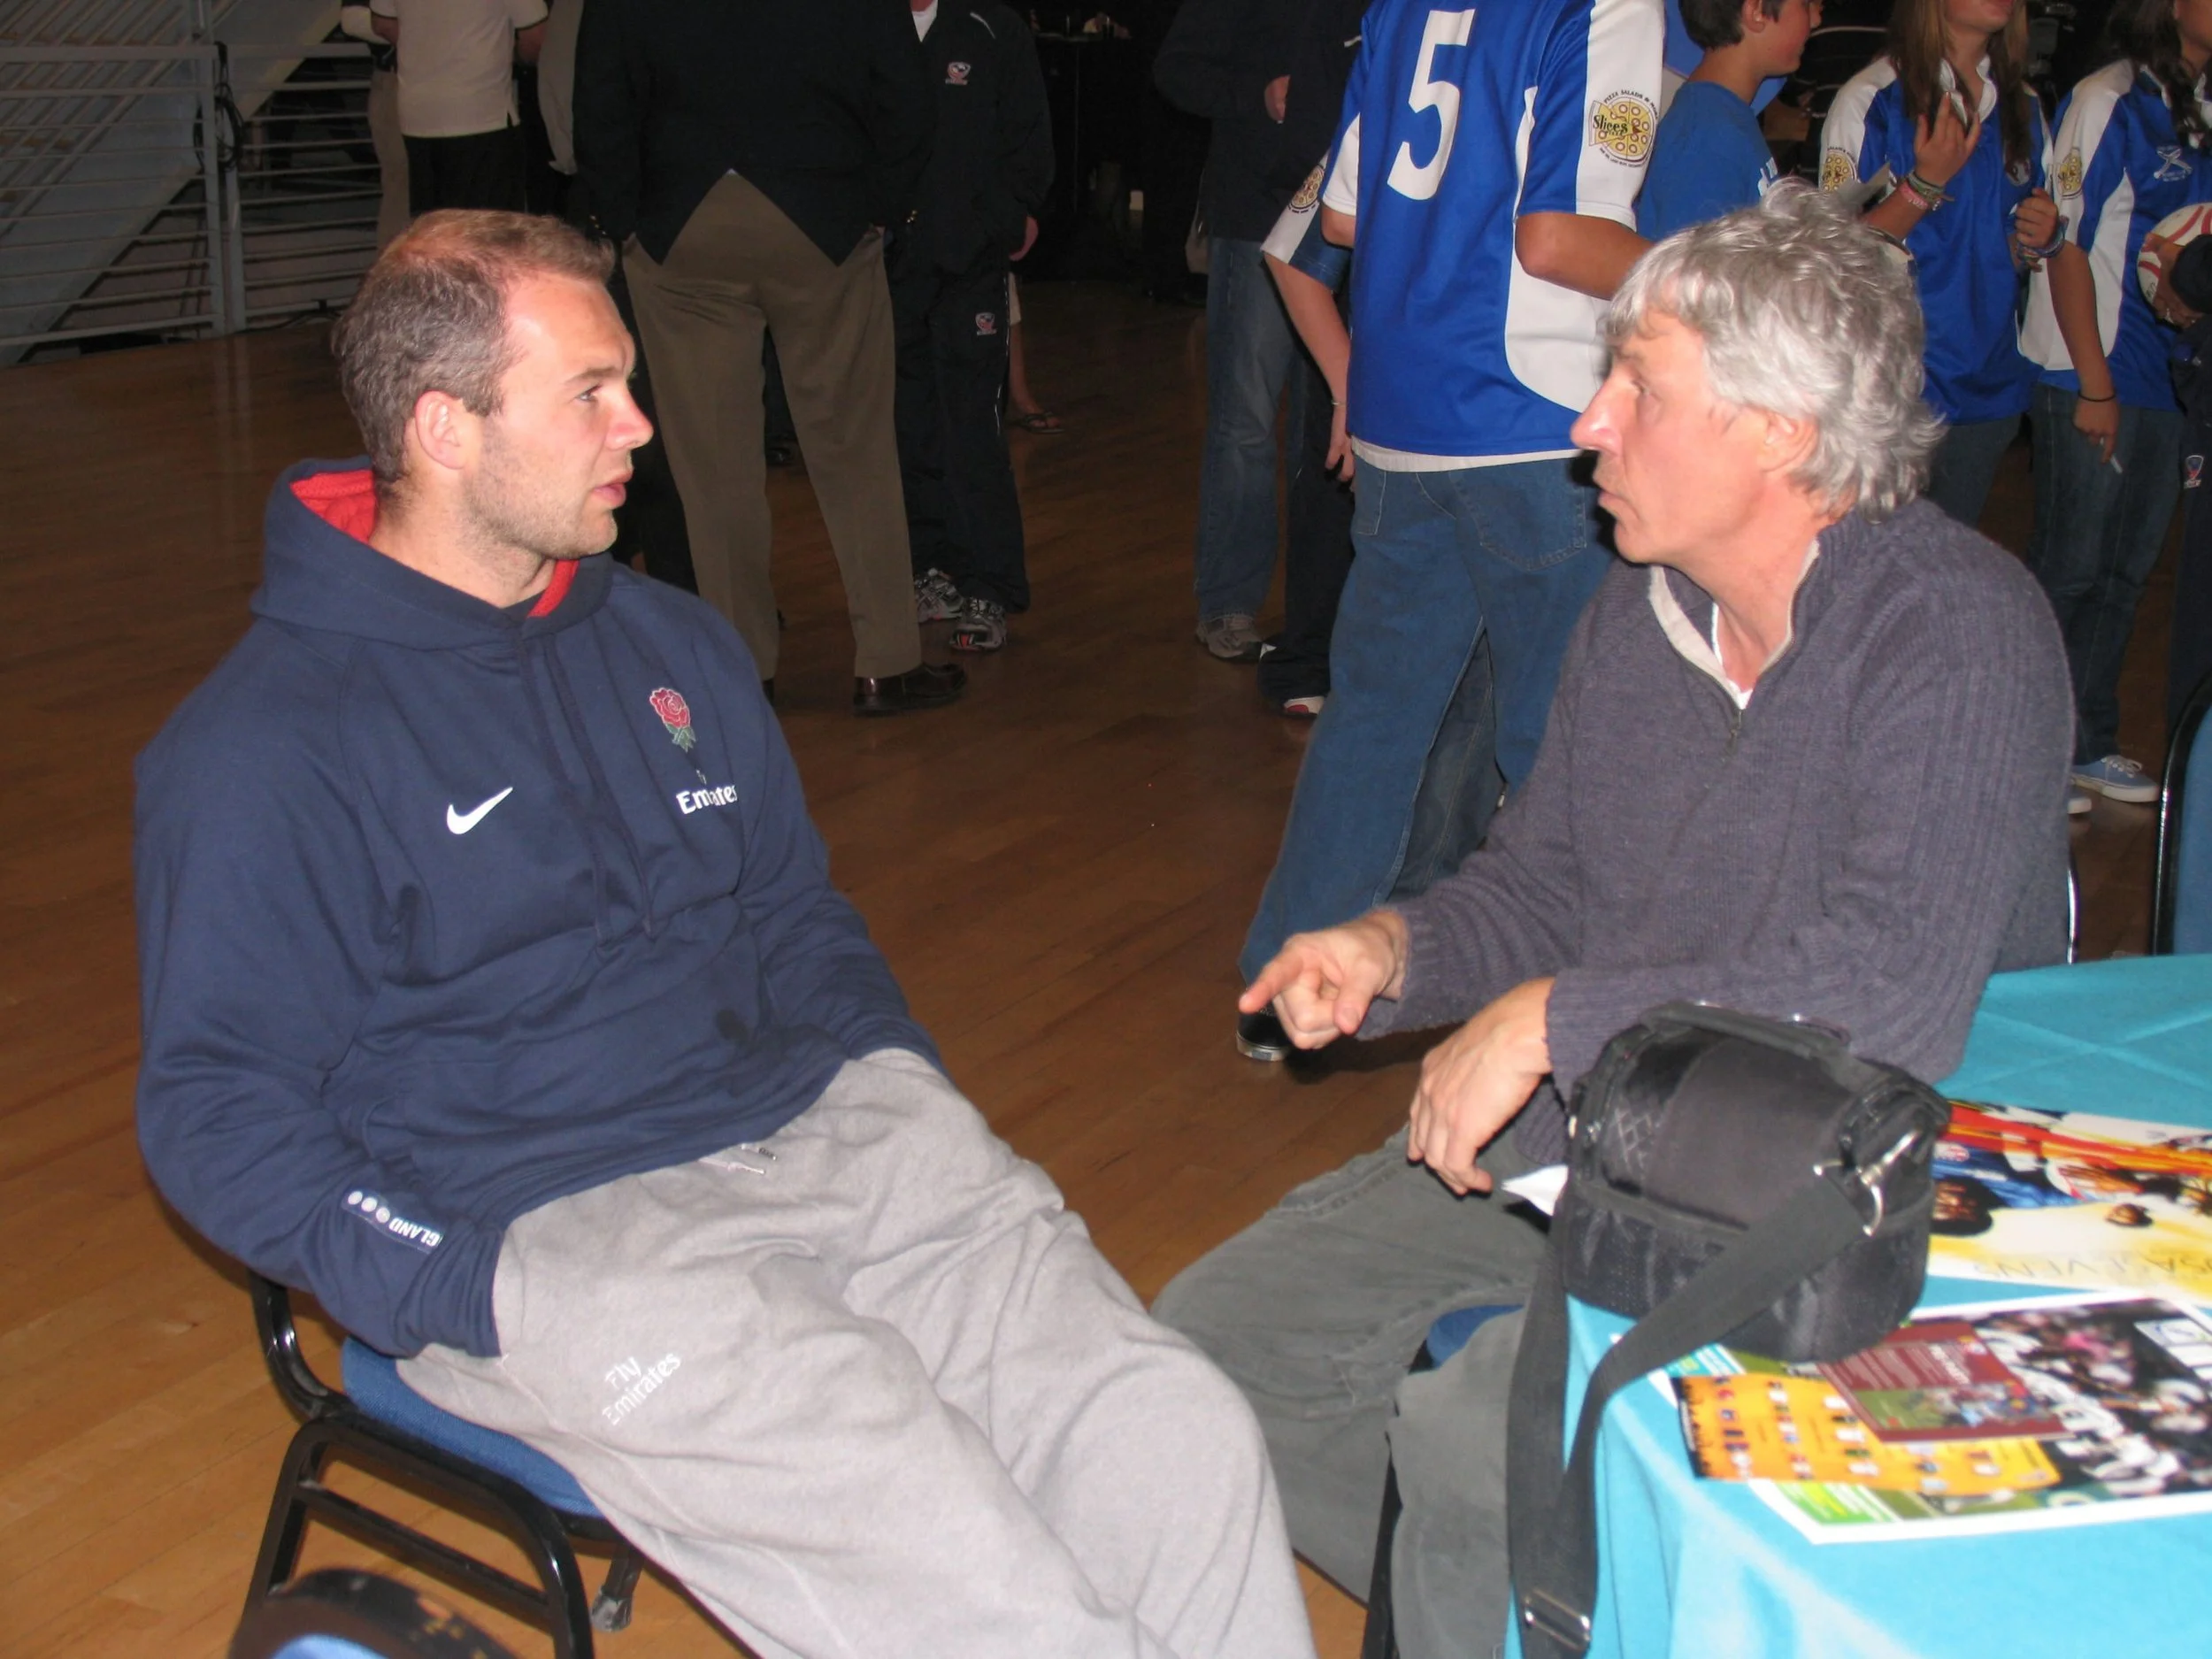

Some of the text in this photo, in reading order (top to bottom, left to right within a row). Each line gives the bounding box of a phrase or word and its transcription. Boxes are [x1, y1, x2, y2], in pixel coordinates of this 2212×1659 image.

[1386, 9, 1476, 201] 5
[1593, 115, 1628, 134] Slices
[602, 1353, 681, 1425] Emirates
[604, 1356, 642, 1390] Fly
